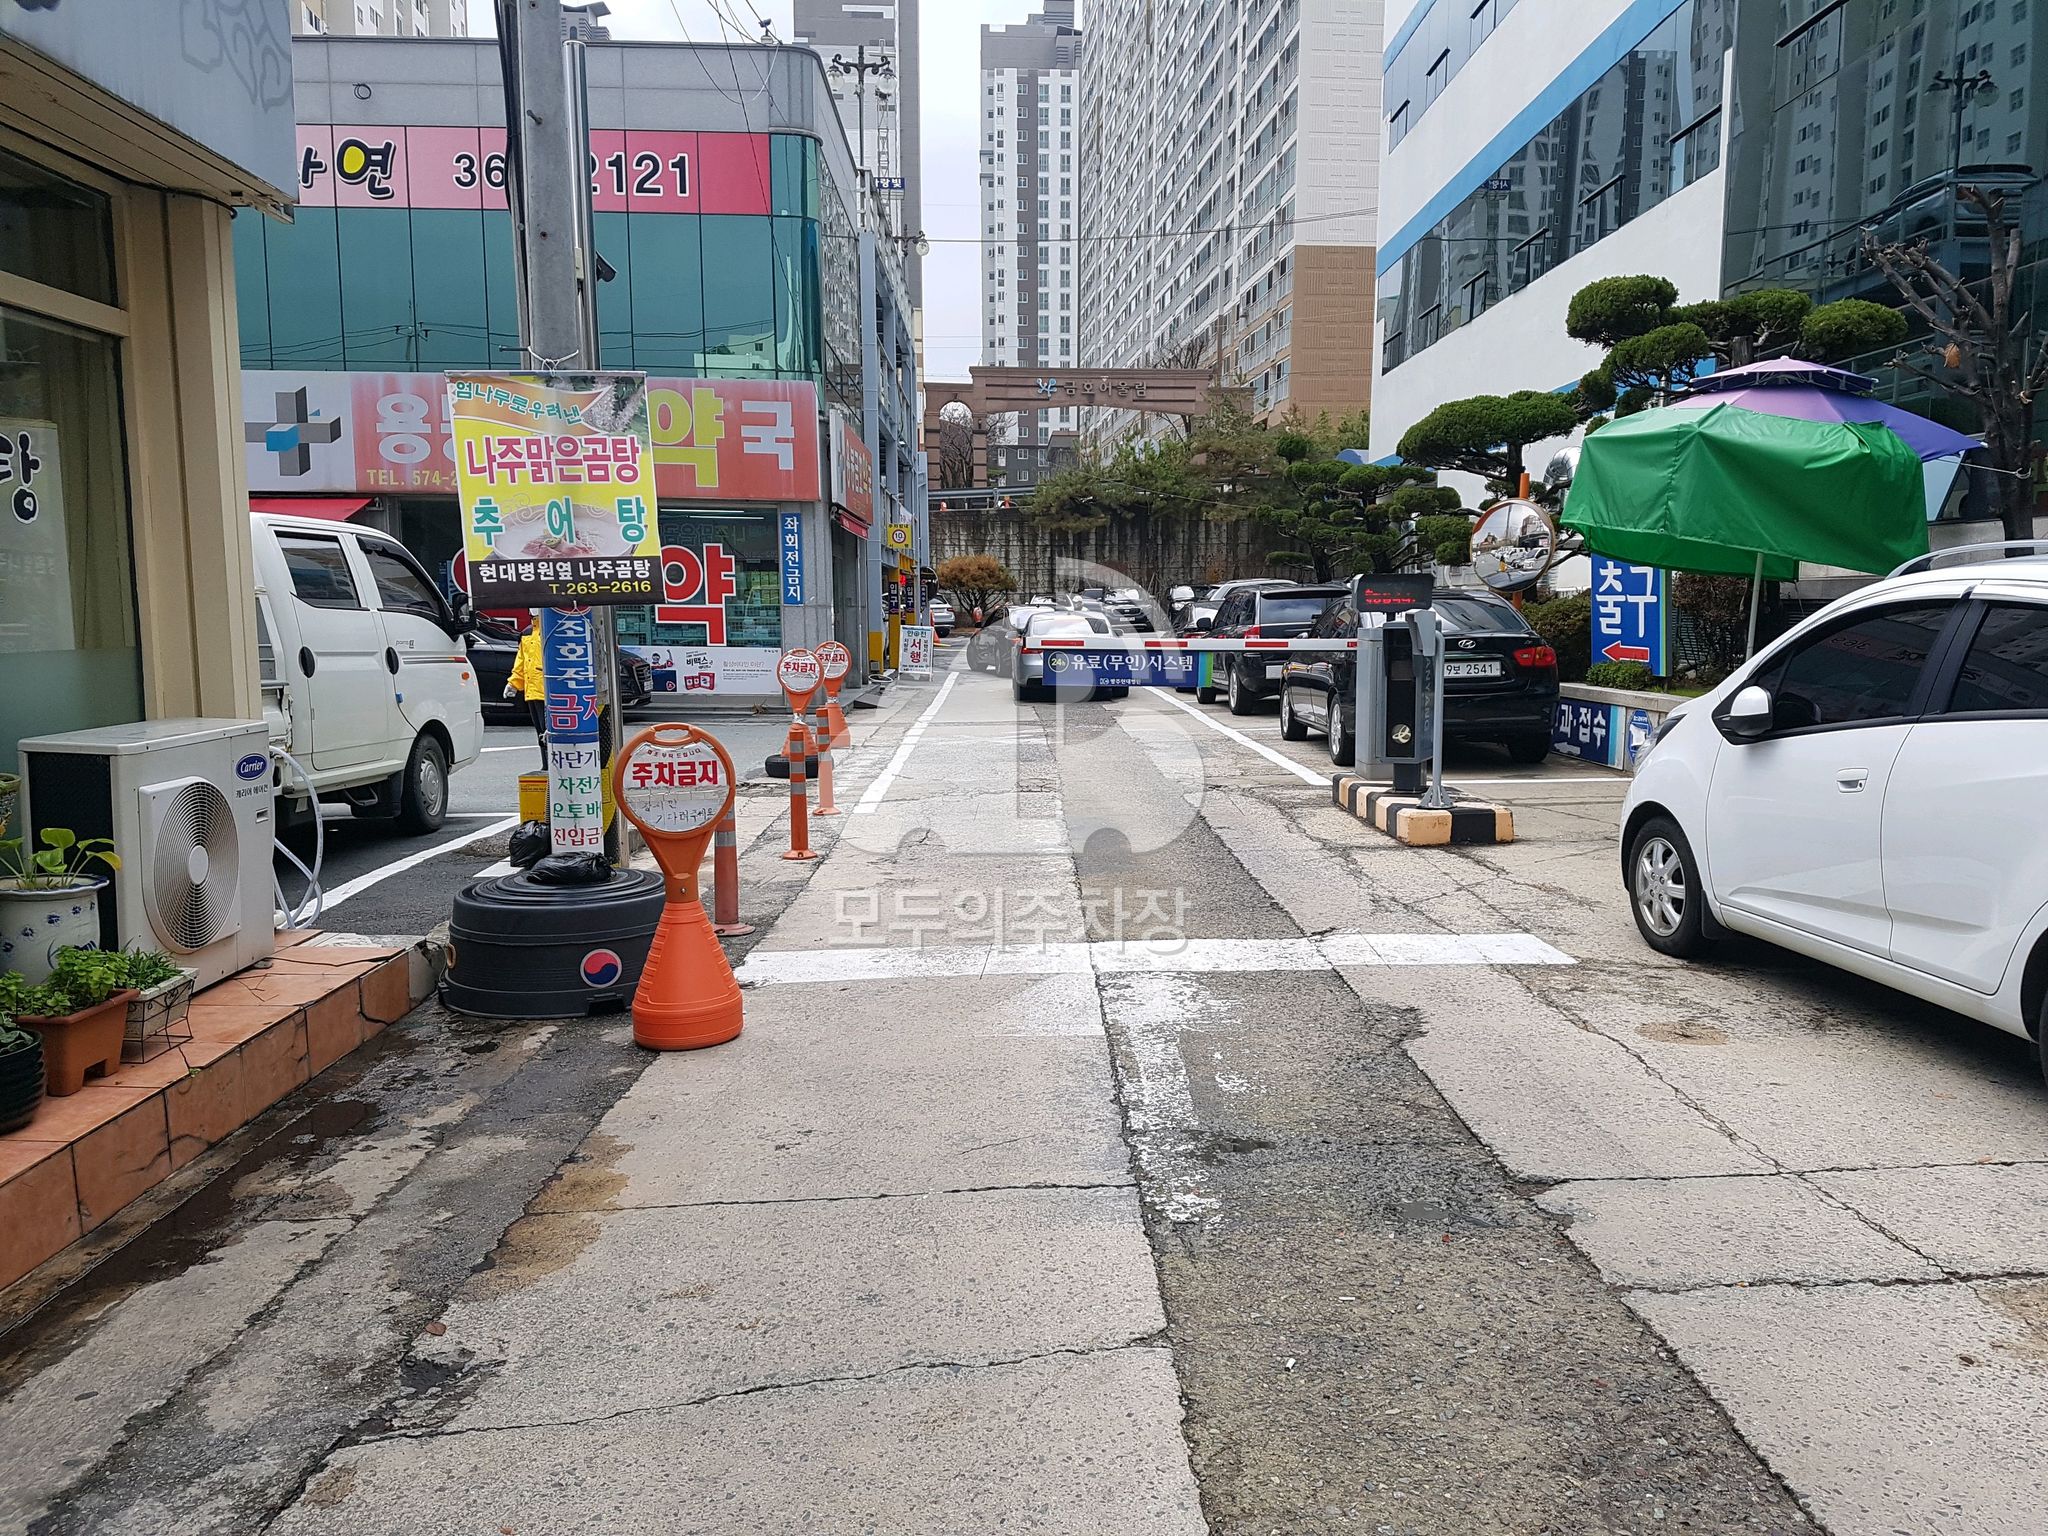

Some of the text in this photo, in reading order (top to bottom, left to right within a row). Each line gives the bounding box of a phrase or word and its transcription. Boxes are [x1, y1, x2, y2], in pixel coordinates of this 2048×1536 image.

[1064, 381, 1147, 397] 금호어울림
[455, 381, 583, 426] 엄나무로우려낸
[650, 387, 795, 489] 약국
[465, 435, 642, 486] 나주맑은곰탕
[366, 469, 405, 485] TEL.
[784, 516, 801, 602] 좌회전금지
[478, 559, 651, 584] 현대병원옆 나주곰탕
[548, 580, 652, 596] T.263-2616
[654, 543, 738, 647] 약
[889, 583, 899, 608] 입구
[1595, 560, 1658, 638] 출구
[783, 661, 816, 673] 주차금지
[1071, 655, 1194, 672] 유료(무인)시스템
[1466, 663, 1494, 675] 2541
[240, 760, 264, 774] Carrier
[632, 760, 719, 788] 주차금지
[553, 801, 601, 819] 오토바
[554, 827, 603, 847] 진입금
